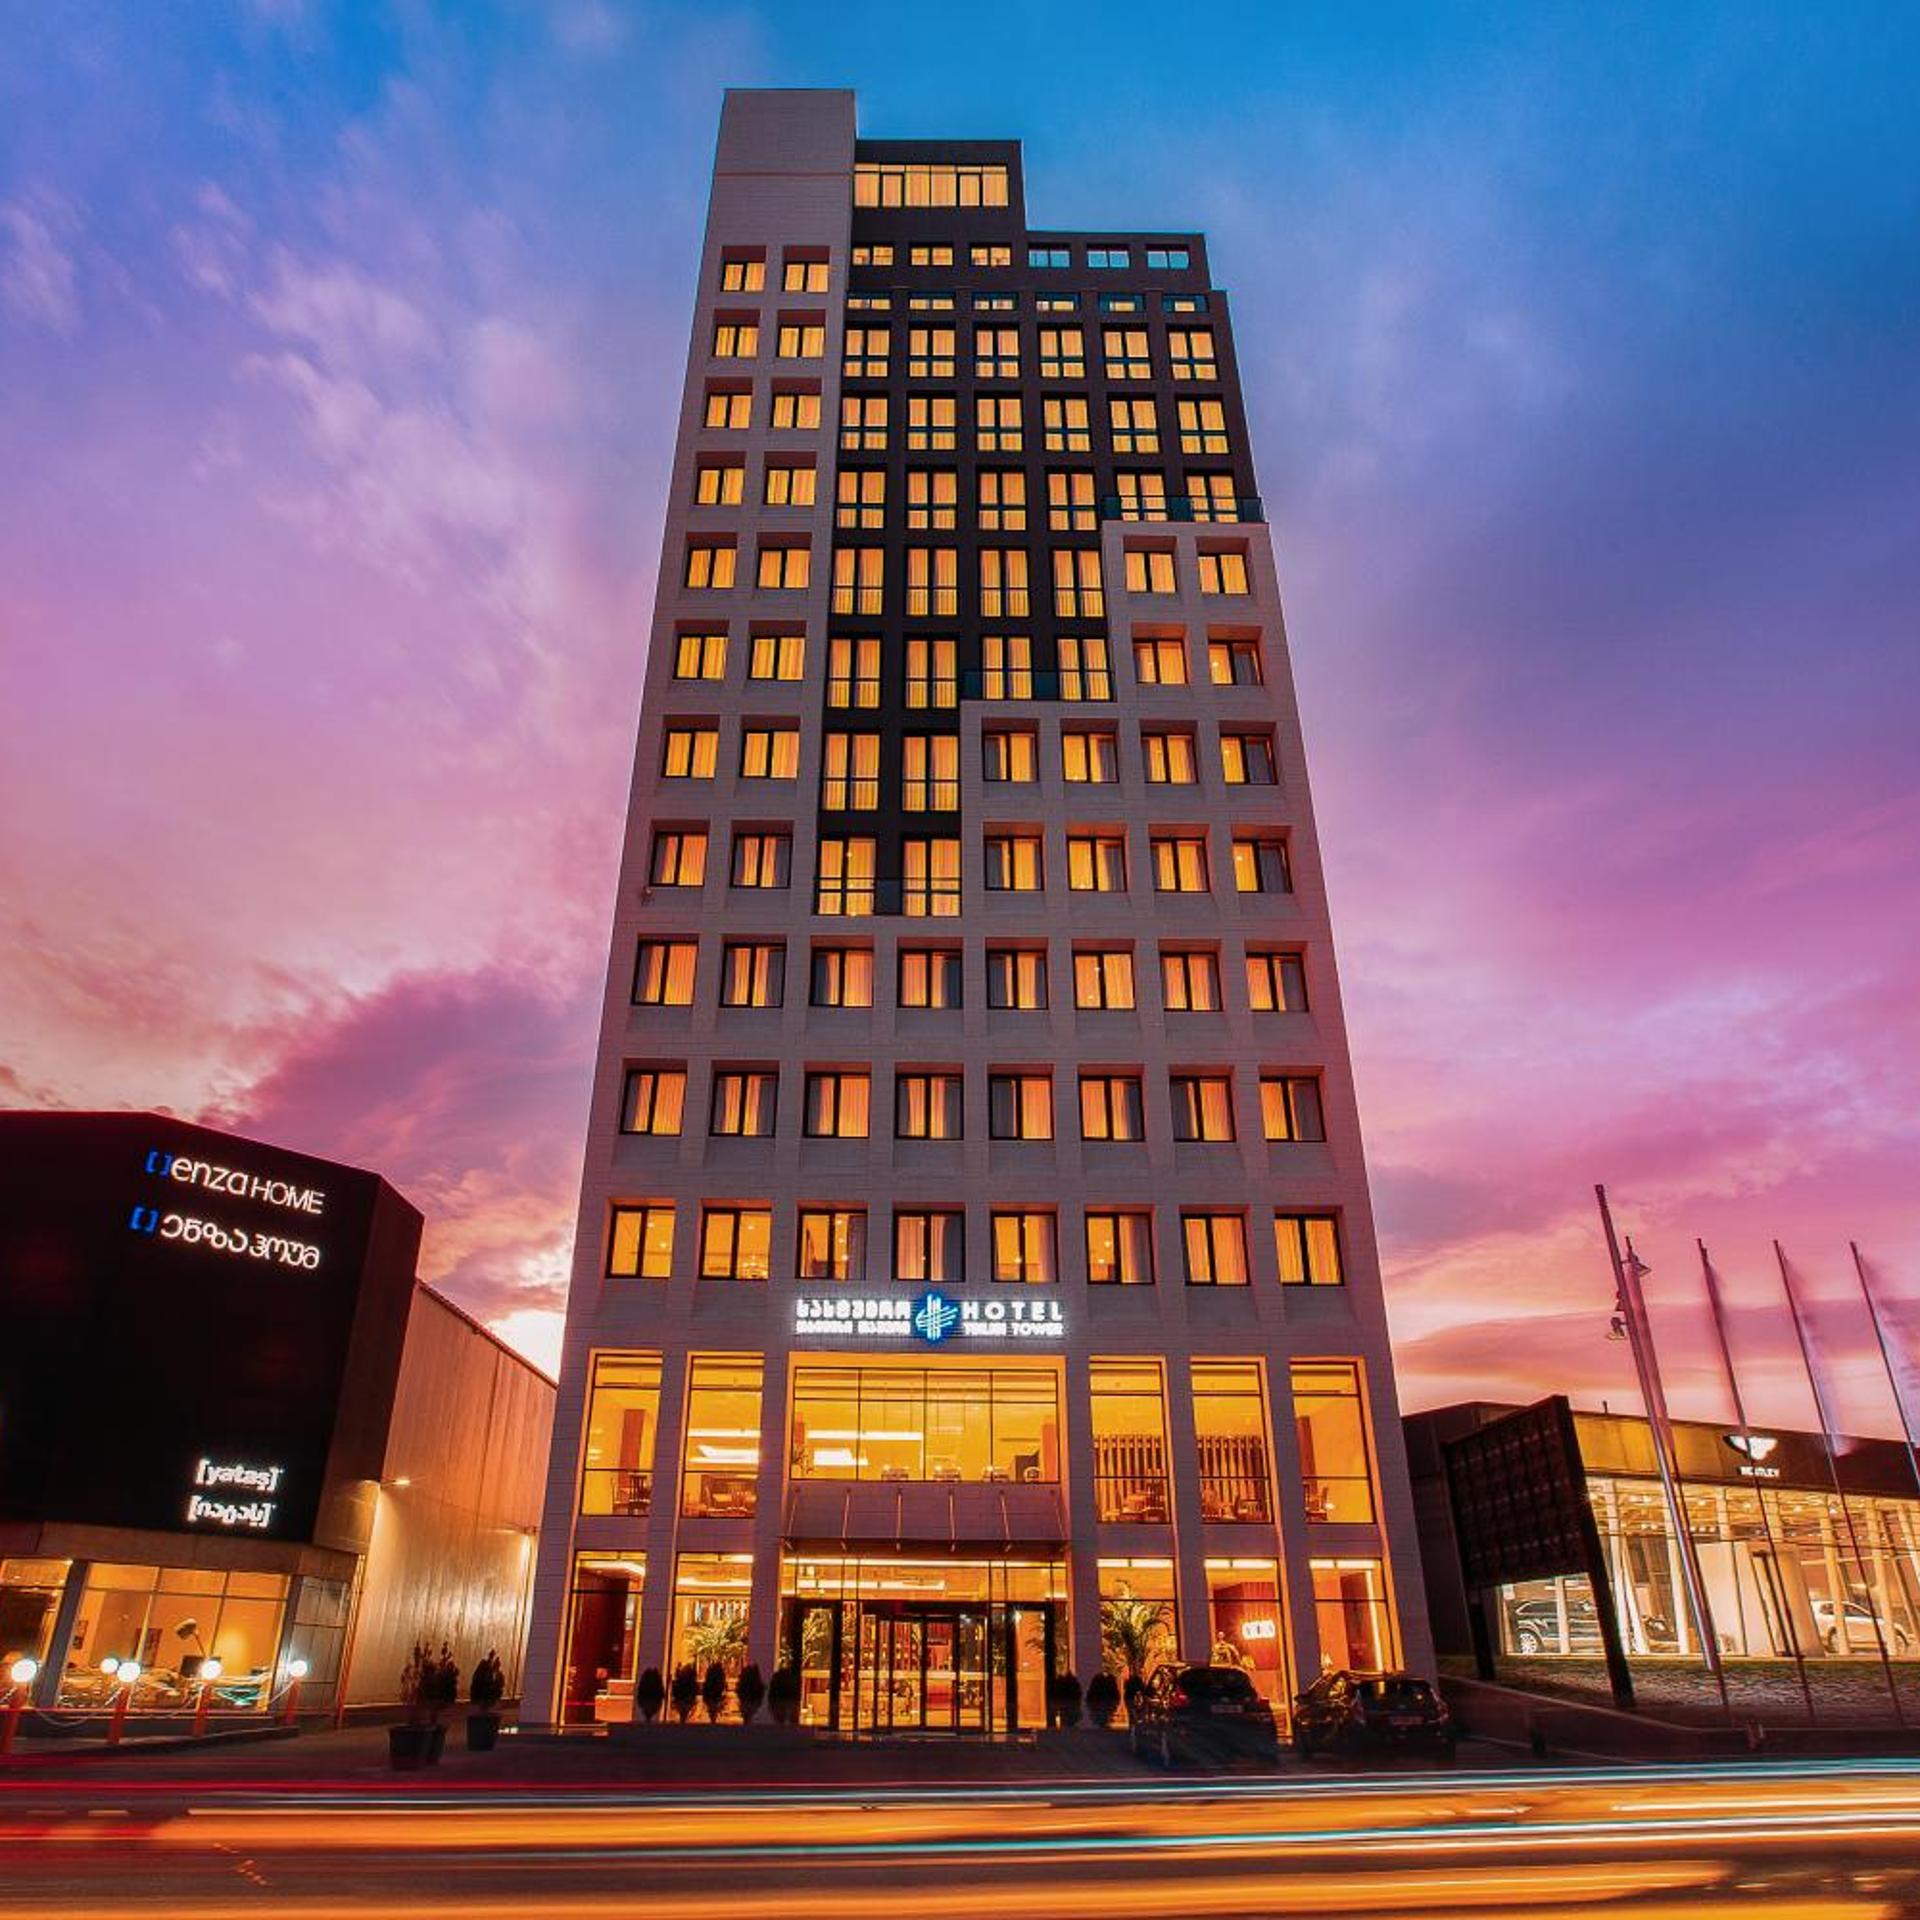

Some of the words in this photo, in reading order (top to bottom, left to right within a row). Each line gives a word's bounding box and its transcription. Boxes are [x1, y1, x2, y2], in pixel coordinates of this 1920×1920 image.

[170, 1157, 249, 1196] enza
[250, 1177, 326, 1215] HOME
[962, 1300, 1063, 1321] HOTEL
